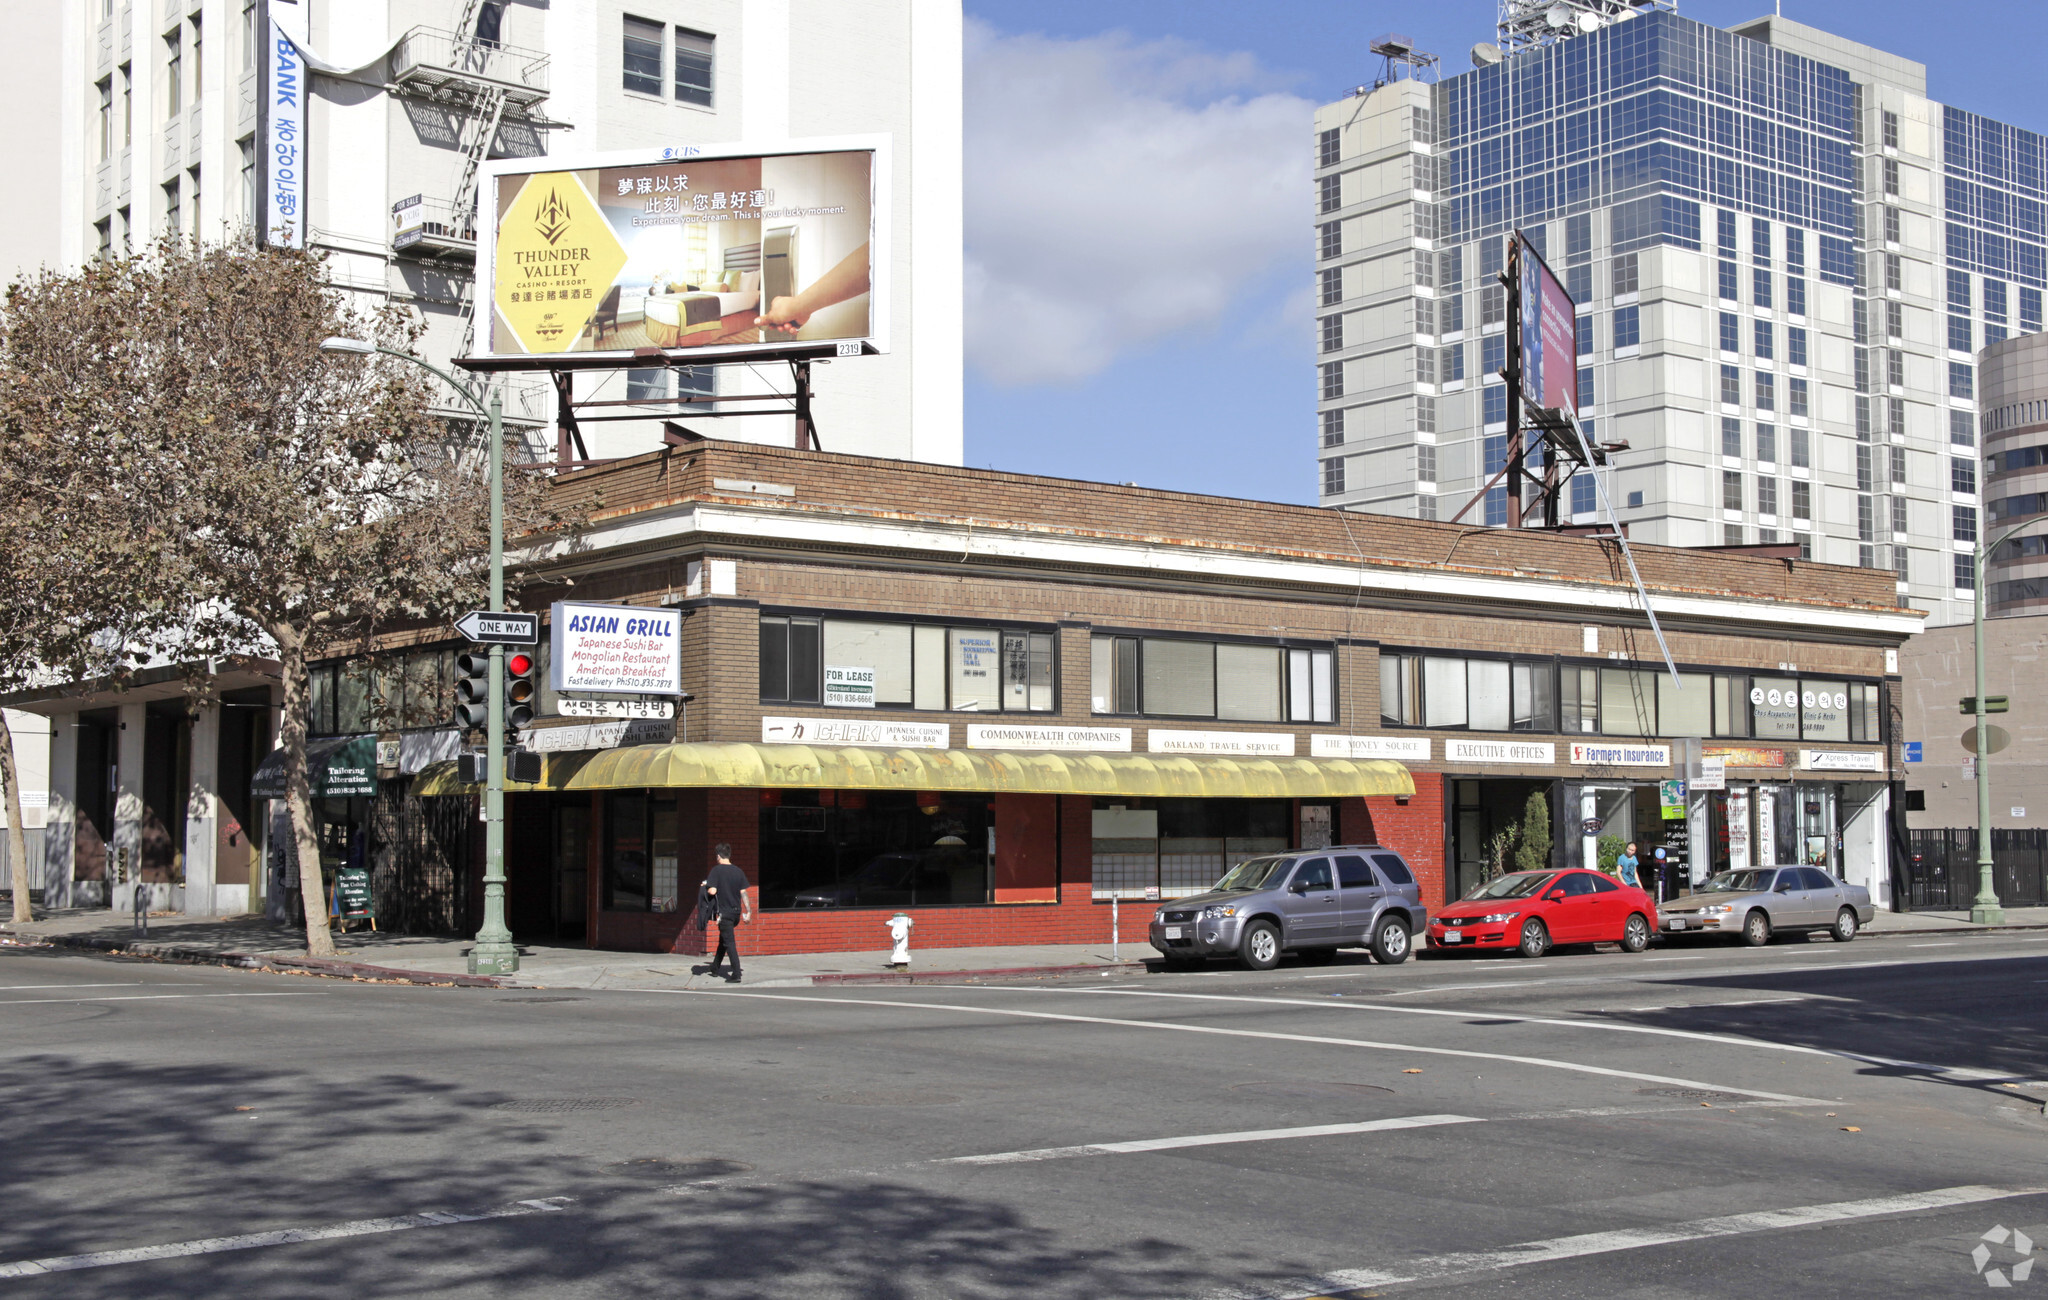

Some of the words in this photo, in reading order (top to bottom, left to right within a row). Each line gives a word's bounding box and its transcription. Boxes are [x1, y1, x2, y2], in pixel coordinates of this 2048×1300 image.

[277, 39, 296, 108] BANK
[675, 146, 700, 157] CBS
[397, 200, 405, 210] FOR
[406, 195, 418, 206] SALE
[632, 216, 679, 227] Experience
[680, 216, 699, 225] your
[701, 212, 730, 222] dream.
[733, 210, 751, 220] This
[753, 210, 760, 219] is
[762, 210, 782, 219] your
[783, 207, 806, 218] lucky
[808, 205, 846, 215] moment.
[514, 247, 591, 265] THUNDER
[524, 264, 580, 279] VALLEY
[517, 281, 547, 289] CASINO
[556, 279, 587, 287] RESORT
[840, 344, 859, 354] 2319
[480, 622, 501, 633] ONE
[505, 623, 527, 634] WAY
[569, 615, 619, 634] ASIAN
[626, 618, 671, 637] GRILL
[578, 636, 622, 650] Japanese
[623, 638, 646, 650] Sushi
[648, 640, 663, 651] Bar
[572, 651, 620, 664] Mongolian
[622, 651, 671, 665] Restaurant
[576, 663, 620, 675] American
[622, 665, 666, 678] Breakfast
[826, 670, 843, 680] FOR
[847, 671, 873, 682] LEASE
[568, 676, 583, 685] Fast
[584, 677, 613, 688] delivery
[826, 693, 843, 703] (510)
[1767, 710, 1797, 719] Acupuncture
[1804, 712, 1817, 720] Clinic
[1822, 713, 1836, 721] Herbs
[595, 727, 633, 738] JAPANESE
[638, 723, 671, 732] CUISINE
[886, 727, 916, 735] JAPANESE
[919, 728, 943, 736] CUISINE
[980, 729, 1064, 741] COMMONWEALTH
[1068, 731, 1121, 742] COMPANIES
[613, 733, 641, 743] SUSHI
[646, 731, 665, 740] BAR
[1164, 741, 1205, 749] OAKLAND
[1210, 742, 1240, 750] TRAVEL
[1246, 743, 1280, 751] SERVICE
[1324, 739, 1342, 748] THE
[1348, 740, 1379, 750] MONEY
[1385, 741, 1419, 751] SOURCE
[1457, 744, 1505, 758] EXECUTIVE
[1510, 746, 1545, 759] OFFICES
[1586, 747, 1622, 762] Farmers
[1624, 748, 1664, 763] Insurance
[1760, 750, 1782, 766] CARE
[1825, 754, 1848, 762] Xpress
[1850, 754, 1870, 762] Travel
[328, 767, 366, 775] Tailoring
[328, 776, 369, 784] Alteration
